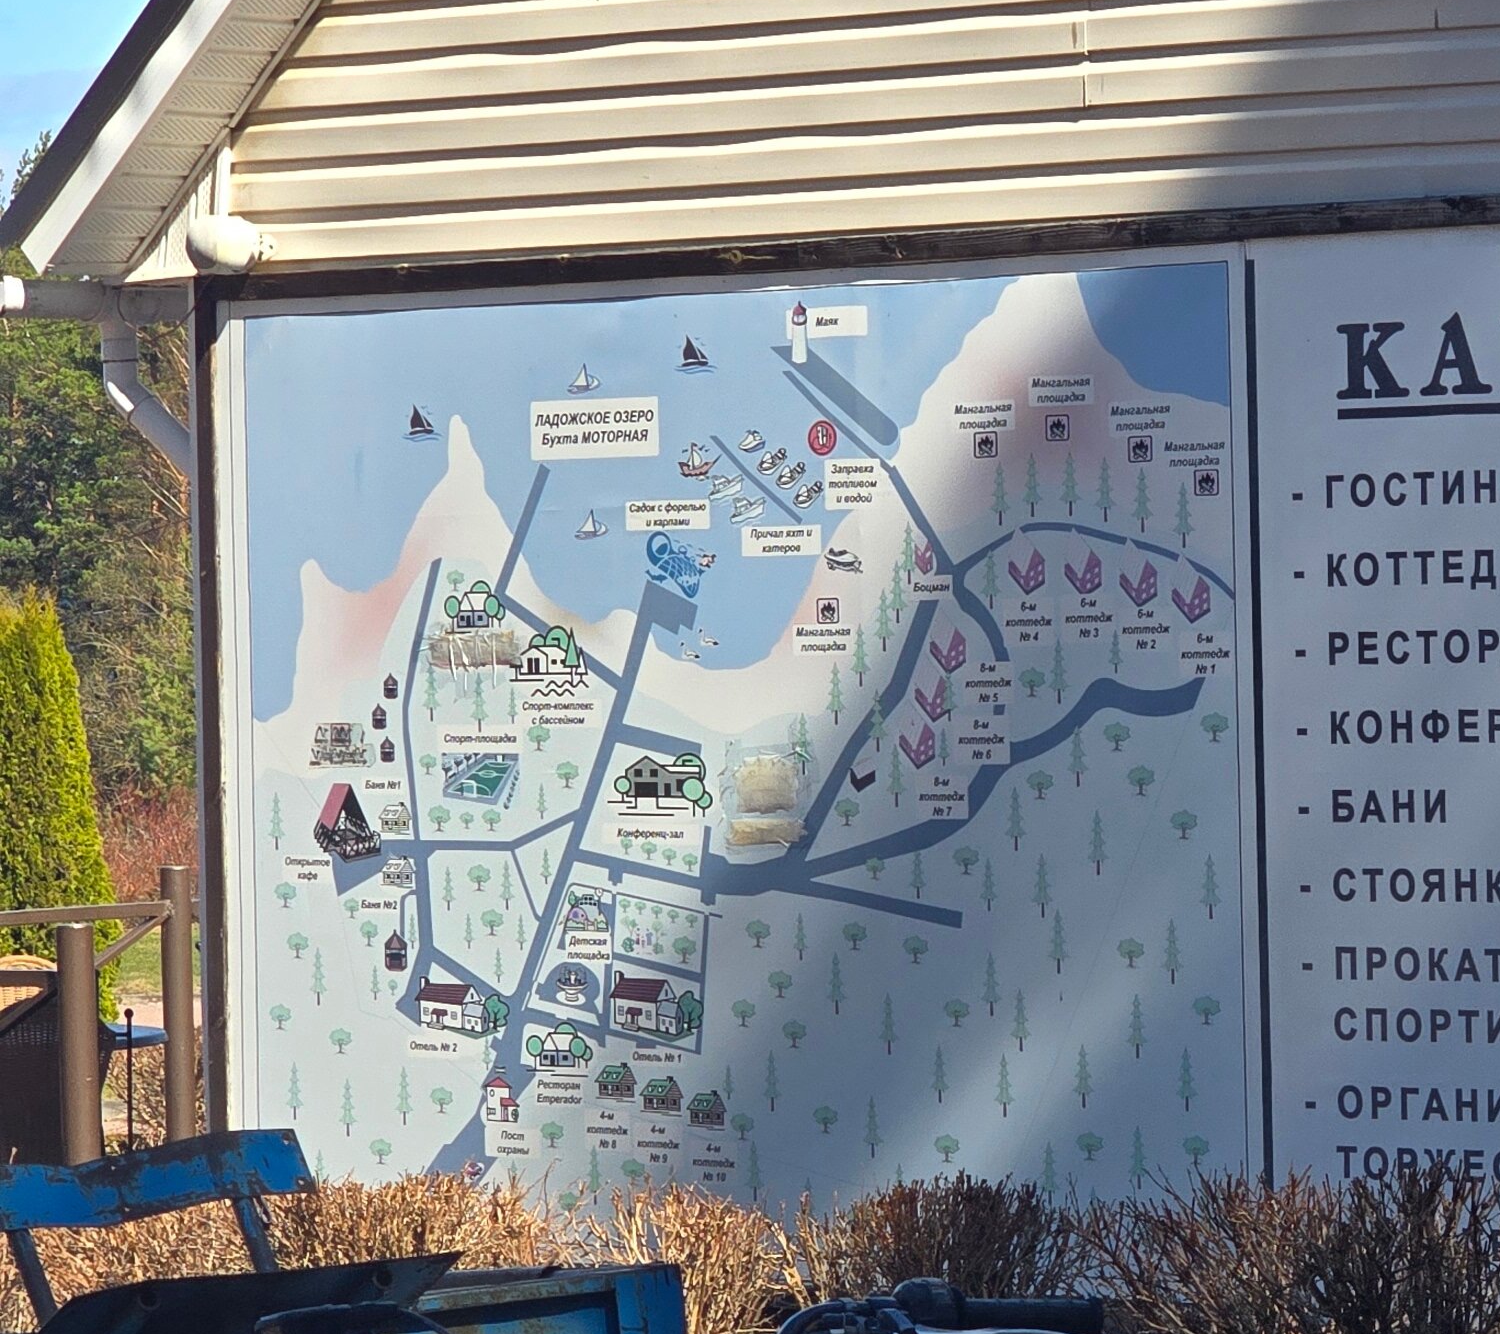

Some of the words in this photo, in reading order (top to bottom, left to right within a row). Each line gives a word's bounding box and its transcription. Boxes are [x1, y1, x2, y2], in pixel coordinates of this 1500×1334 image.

[816, 317, 838, 326] Маяк
[1032, 378, 1090, 388] Мангальная
[1037, 392, 1085, 403] площадка
[955, 404, 1013, 418] Мангальная
[1111, 406, 1170, 416] Мангальная
[535, 412, 611, 428] ЛАДОЖСКОЕ
[614, 410, 653, 423] ОЗЕРО
[959, 418, 1008, 431] площадка
[1116, 419, 1165, 431] площадка
[542, 433, 578, 448] Бухта
[582, 429, 648, 443] МОТОРНАЯ
[1164, 442, 1225, 451] Мангальная
[1169, 455, 1219, 467] площадка
[831, 464, 874, 475] Заправка
[845, 493, 872, 503] водой
[629, 503, 655, 512] Садок
[665, 502, 706, 513] форелью
[654, 519, 690, 528] карпами
[751, 529, 782, 540] Причал
[762, 545, 800, 554] катеров
[914, 583, 950, 593] Боцман
[1006, 616, 1052, 627] коттедж
[1065, 612, 1113, 623] коттедж
[796, 627, 851, 636] Мангальная
[1122, 623, 1170, 634] коттедж
[801, 641, 846, 652] площадка
[1181, 648, 1230, 659] коттедж
[965, 677, 1012, 688] коттедж
[523, 701, 593, 712] Спорт-комплекс
[539, 715, 584, 728] бассейном
[444, 733, 516, 745] Спорт-площадка
[958, 734, 1004, 744] коттедж
[365, 779, 386, 790] Баня
[919, 791, 965, 801] коттедж
[1332, 790, 1446, 823] БАНИ
[617, 828, 683, 839] Конференц-зал
[285, 857, 330, 868] Открытое
[298, 871, 317, 881] кафе
[361, 899, 381, 909] Баня
[569, 936, 607, 947] Детская
[568, 951, 610, 960] площадка
[409, 1040, 439, 1052] Отель
[633, 1051, 662, 1062] Отель
[537, 1080, 581, 1091] Ресторан
[537, 1094, 583, 1105] Emperador
[587, 1125, 628, 1135] коттедж
[501, 1131, 524, 1141] Пост
[637, 1140, 680, 1149] коттедж
[497, 1146, 529, 1156] охраны
[693, 1158, 735, 1168] коттедж
